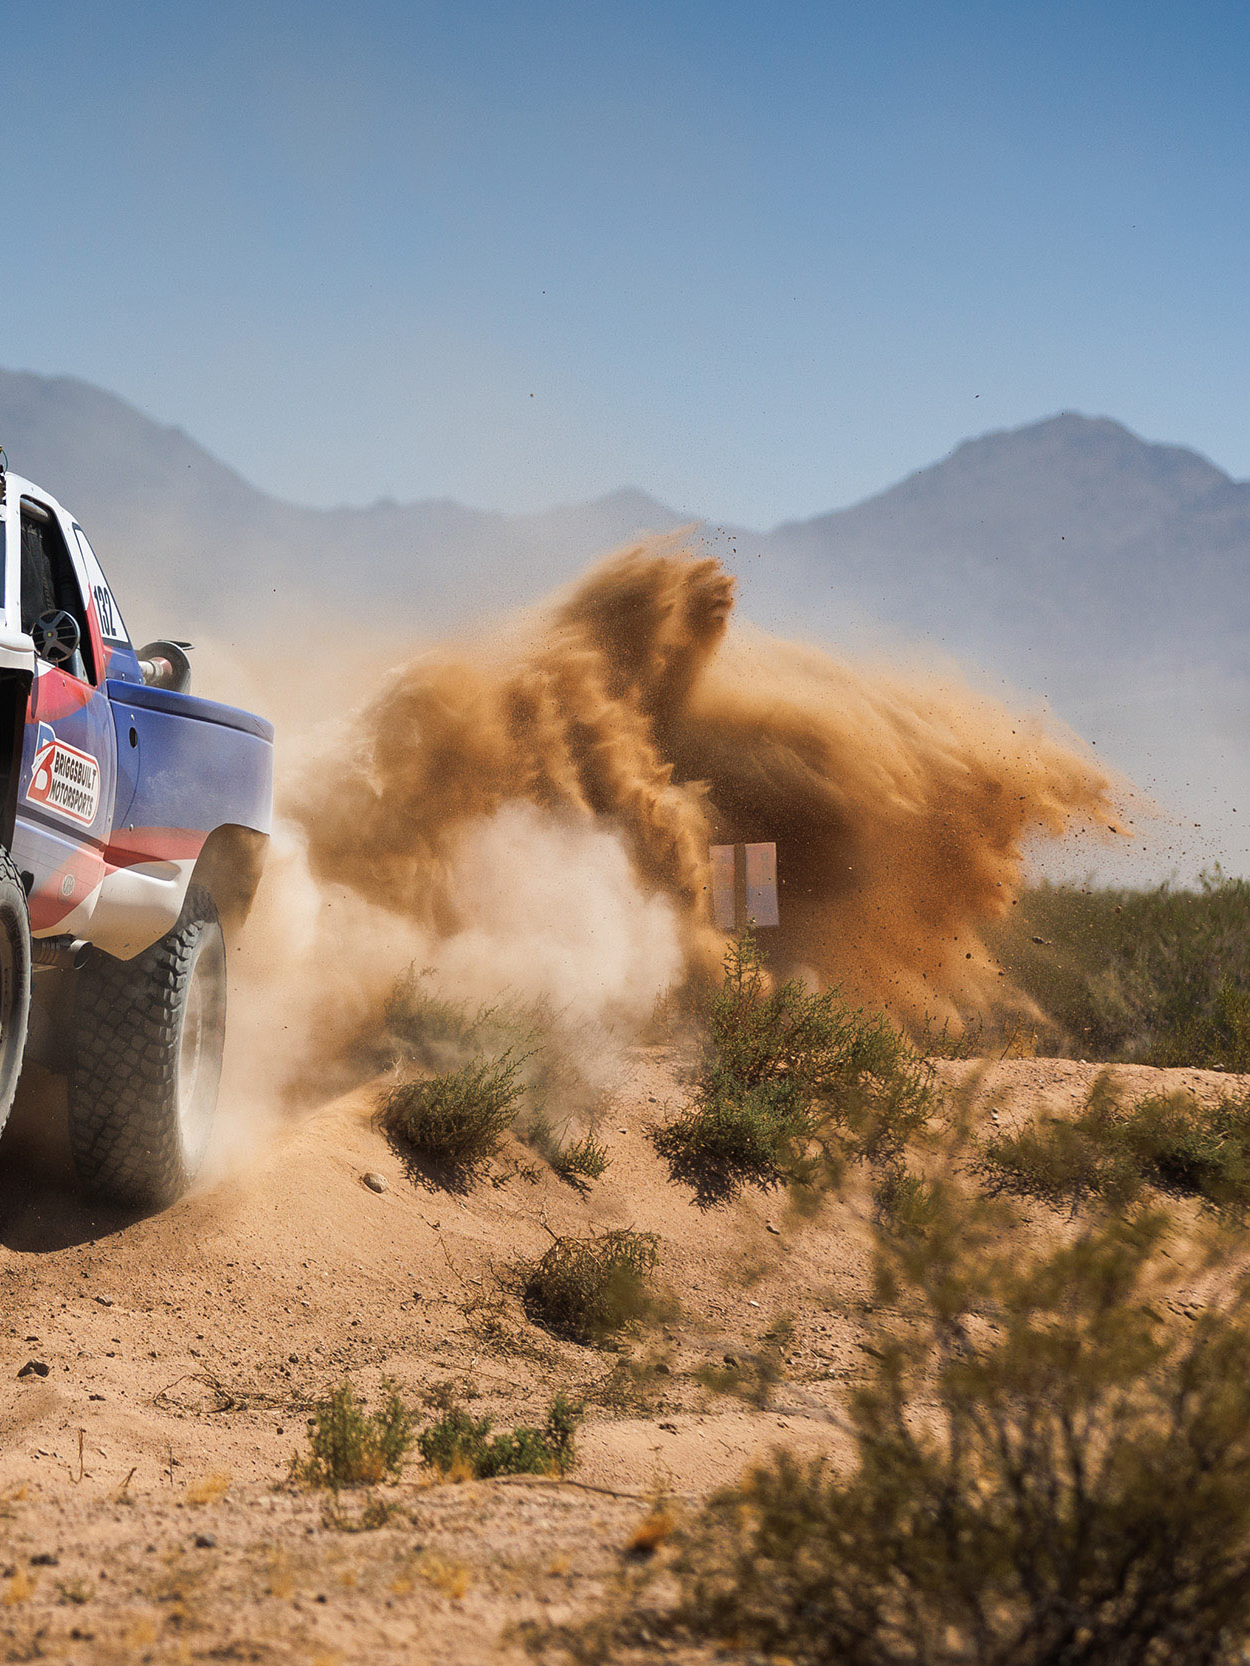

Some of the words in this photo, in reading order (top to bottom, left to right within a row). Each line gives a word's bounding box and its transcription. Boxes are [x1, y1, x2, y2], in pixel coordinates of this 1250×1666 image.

[93, 585, 117, 636] 132
[54, 751, 97, 791] BRIGGSBUILT
[50, 778, 94, 817] MOTORSPORTS
